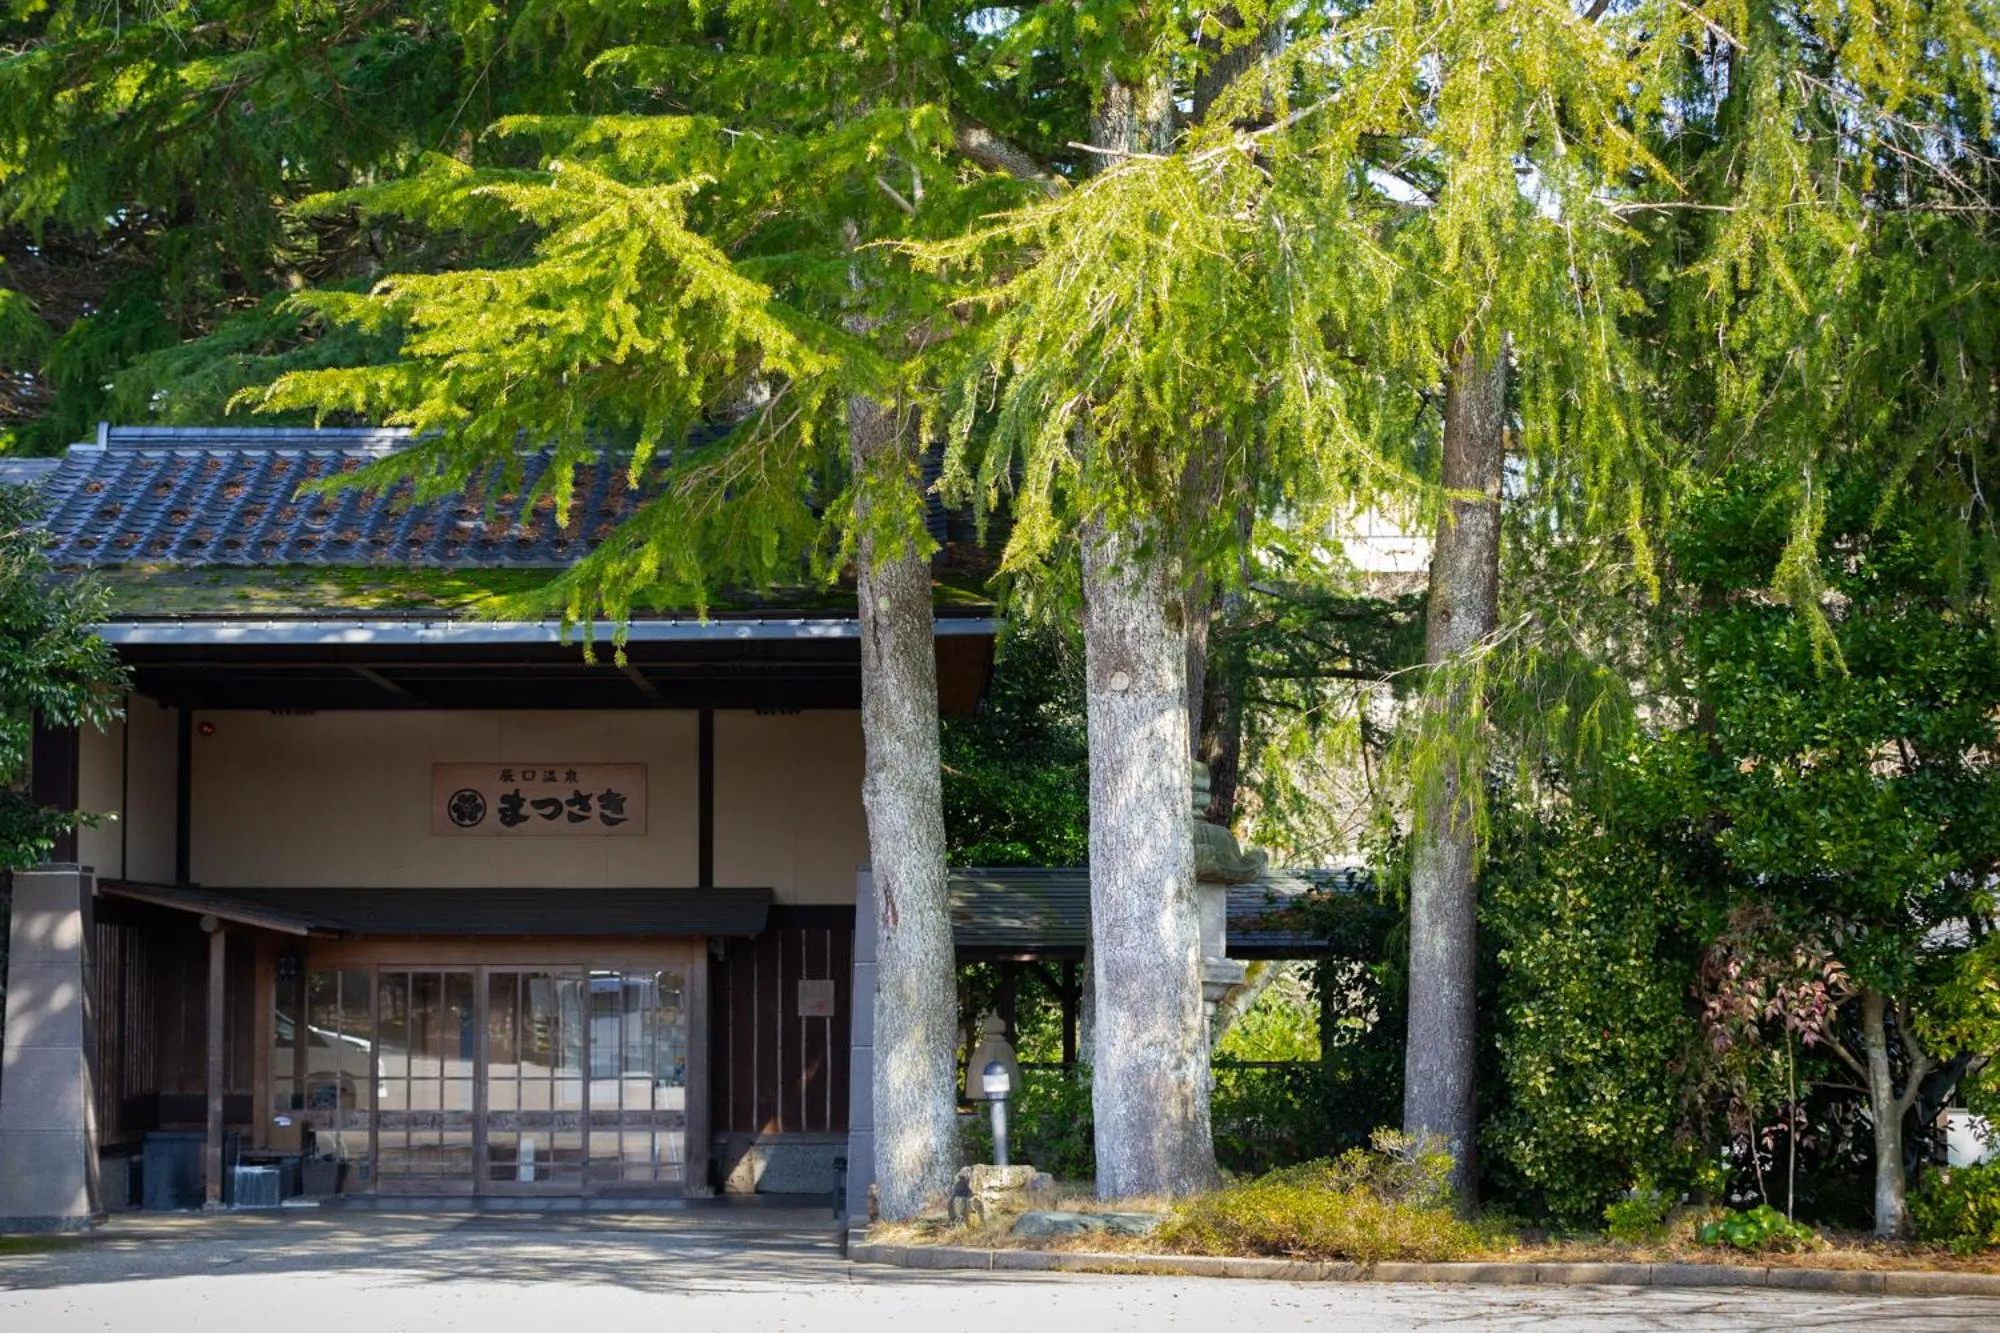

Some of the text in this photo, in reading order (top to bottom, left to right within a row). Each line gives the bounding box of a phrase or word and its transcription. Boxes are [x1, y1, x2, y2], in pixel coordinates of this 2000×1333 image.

[499, 768, 579, 784] 辰口温泉
[498, 788, 629, 827] まつさき
